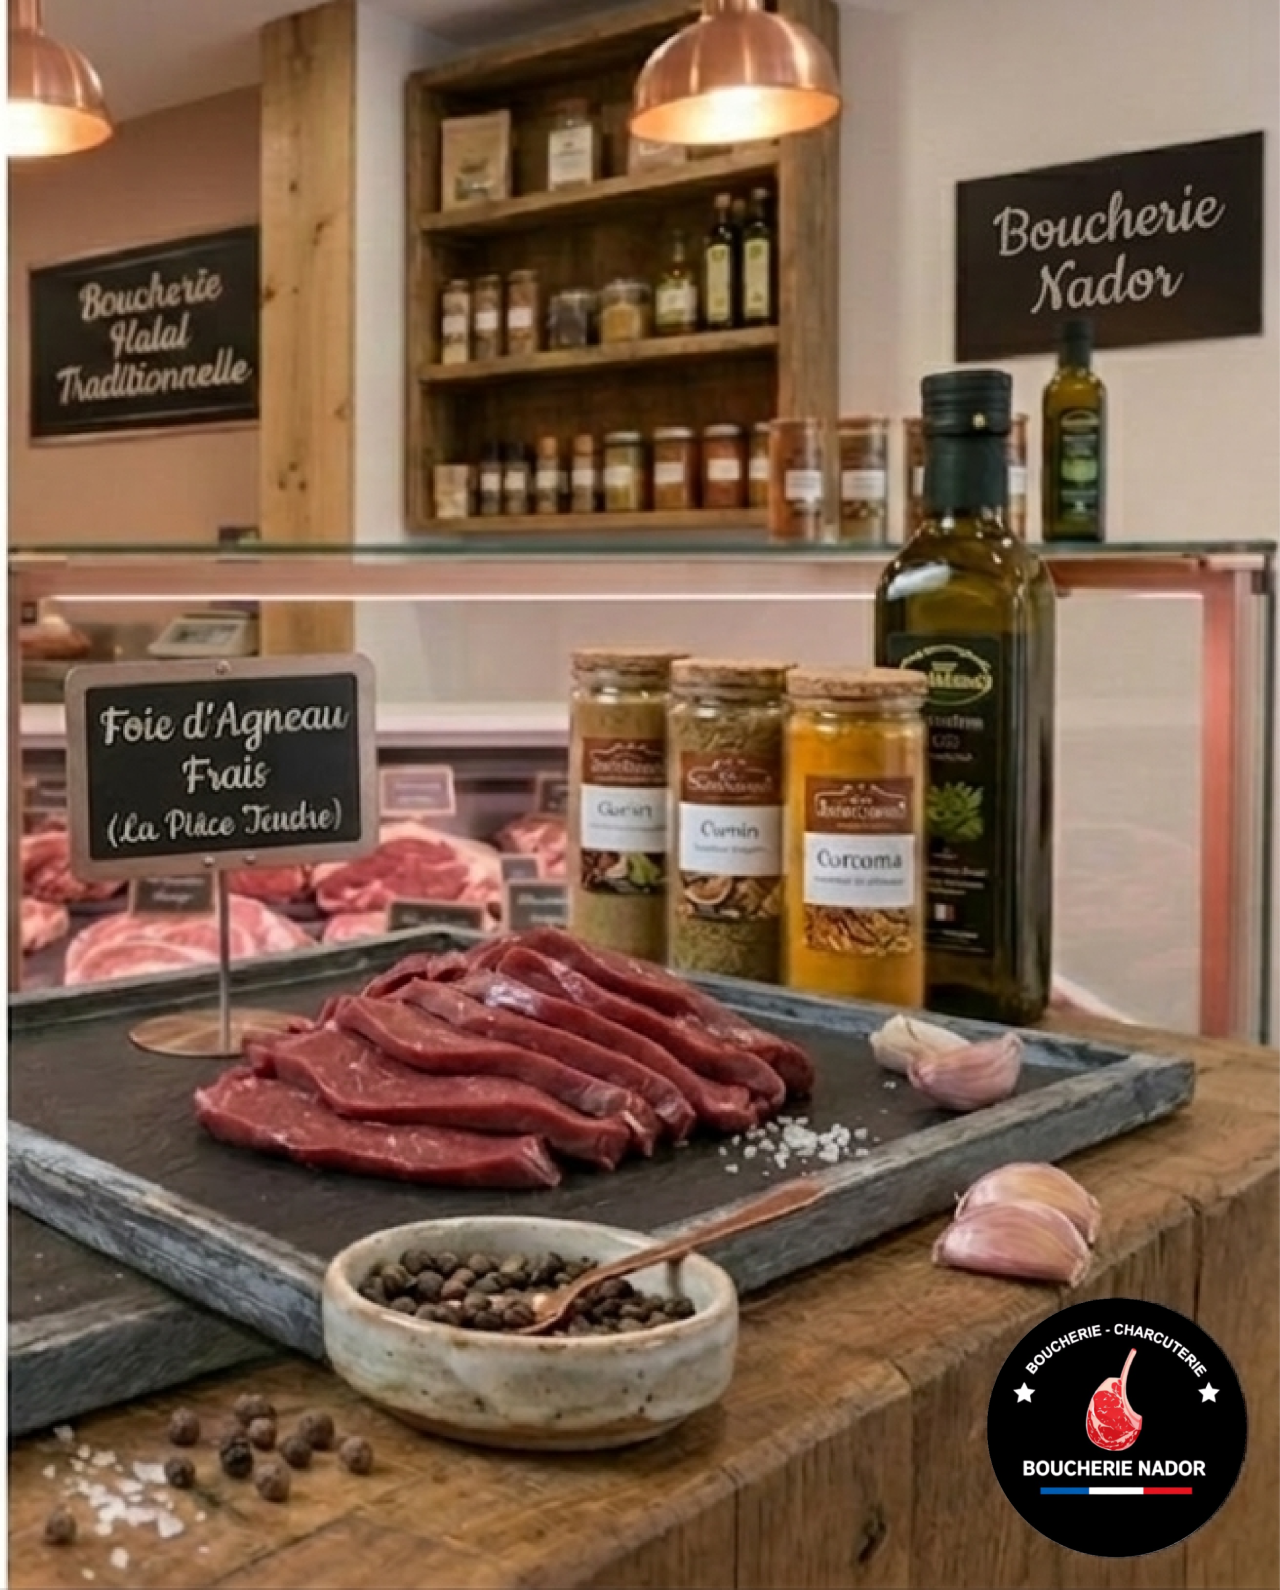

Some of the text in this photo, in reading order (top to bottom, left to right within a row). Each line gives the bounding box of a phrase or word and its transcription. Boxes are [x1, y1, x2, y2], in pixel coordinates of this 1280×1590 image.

[992, 184, 1225, 256] Boucherie
[79, 267, 222, 321] Boucherie
[1030, 253, 1183, 315] Nador
[110, 311, 191, 358] Halal
[100, 701, 349, 751] Foie d'Agneau
[182, 755, 269, 794] Frais
